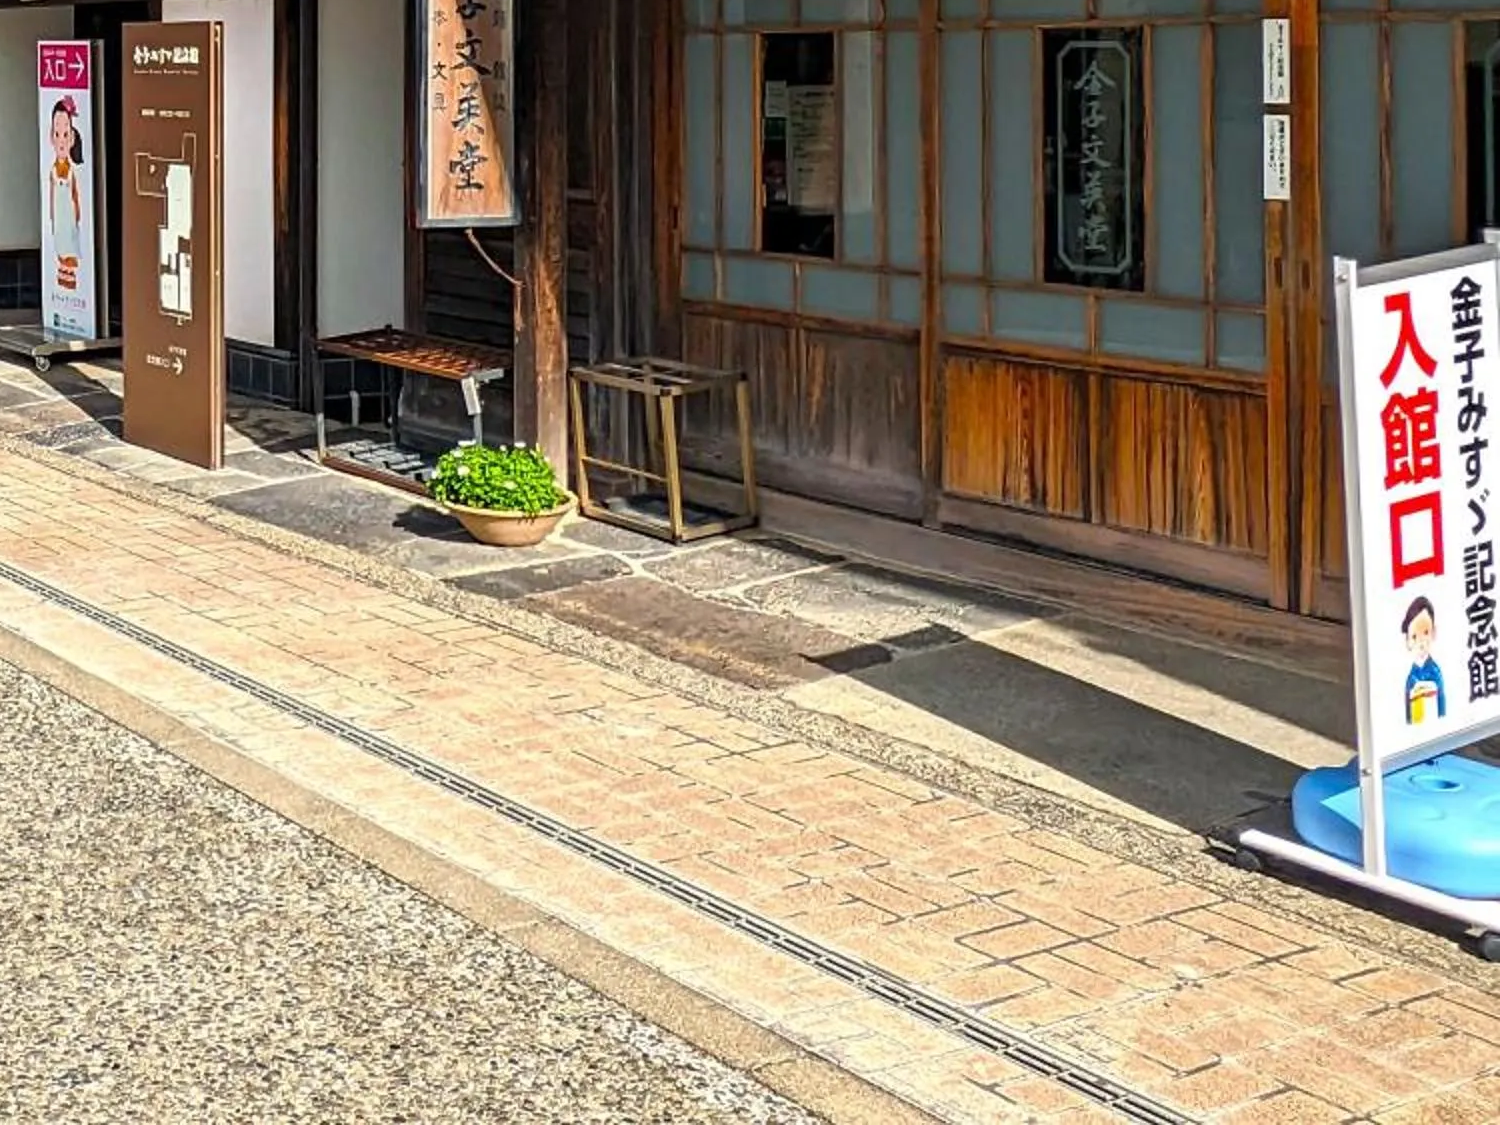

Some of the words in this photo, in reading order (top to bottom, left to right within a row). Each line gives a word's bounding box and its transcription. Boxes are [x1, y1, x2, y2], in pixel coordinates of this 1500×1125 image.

[43, 58, 67, 82] 入口
[1379, 291, 1444, 590] 入館口
